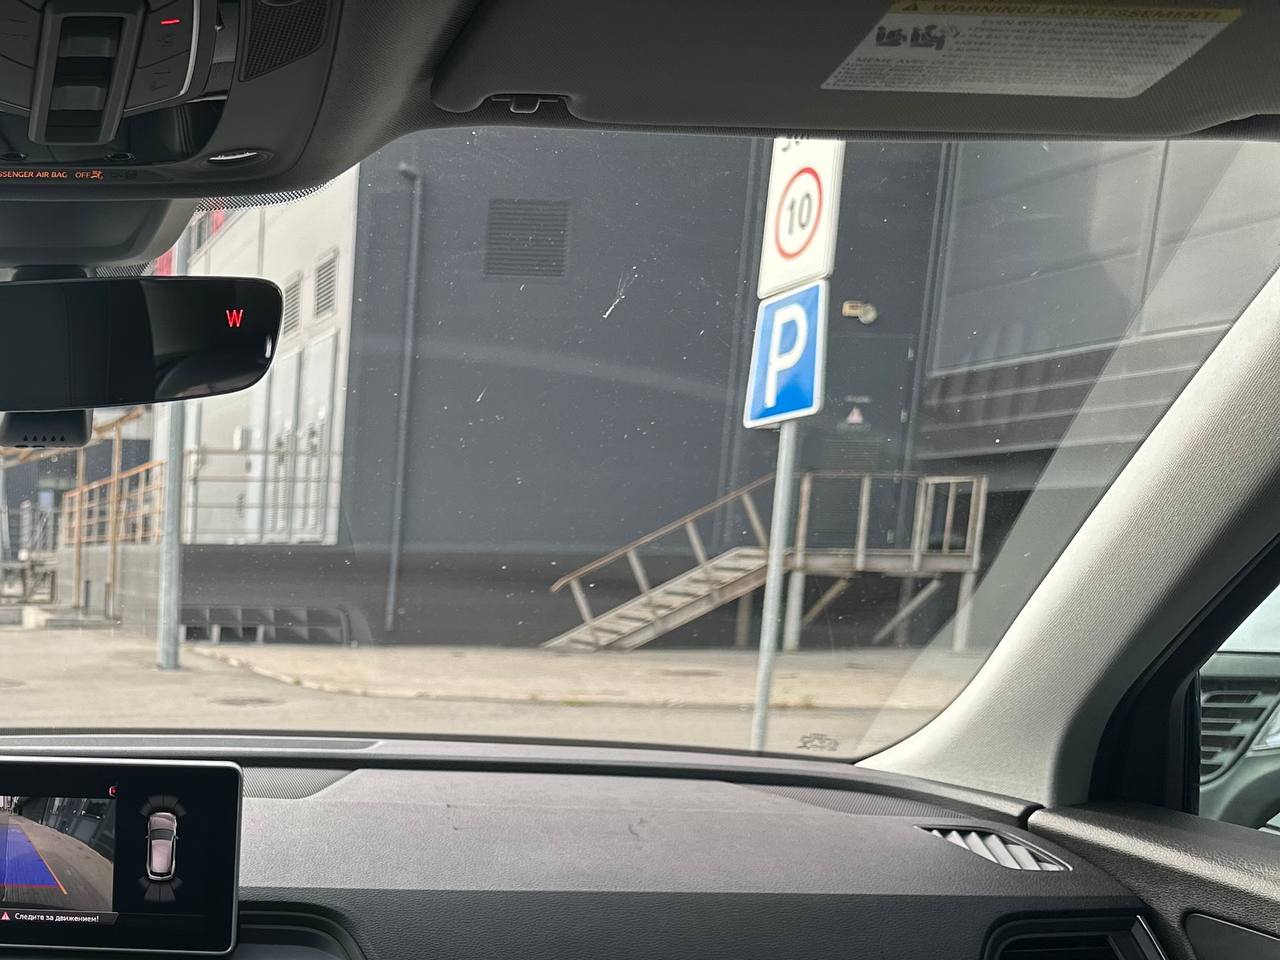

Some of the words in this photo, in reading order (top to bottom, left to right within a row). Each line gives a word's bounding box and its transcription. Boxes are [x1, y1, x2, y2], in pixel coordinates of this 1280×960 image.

[786, 192, 813, 236] 10
[225, 308, 244, 328] W
[764, 302, 808, 408] P
[15, 912, 44, 921] Следите
[55, 914, 99, 922] движением!
